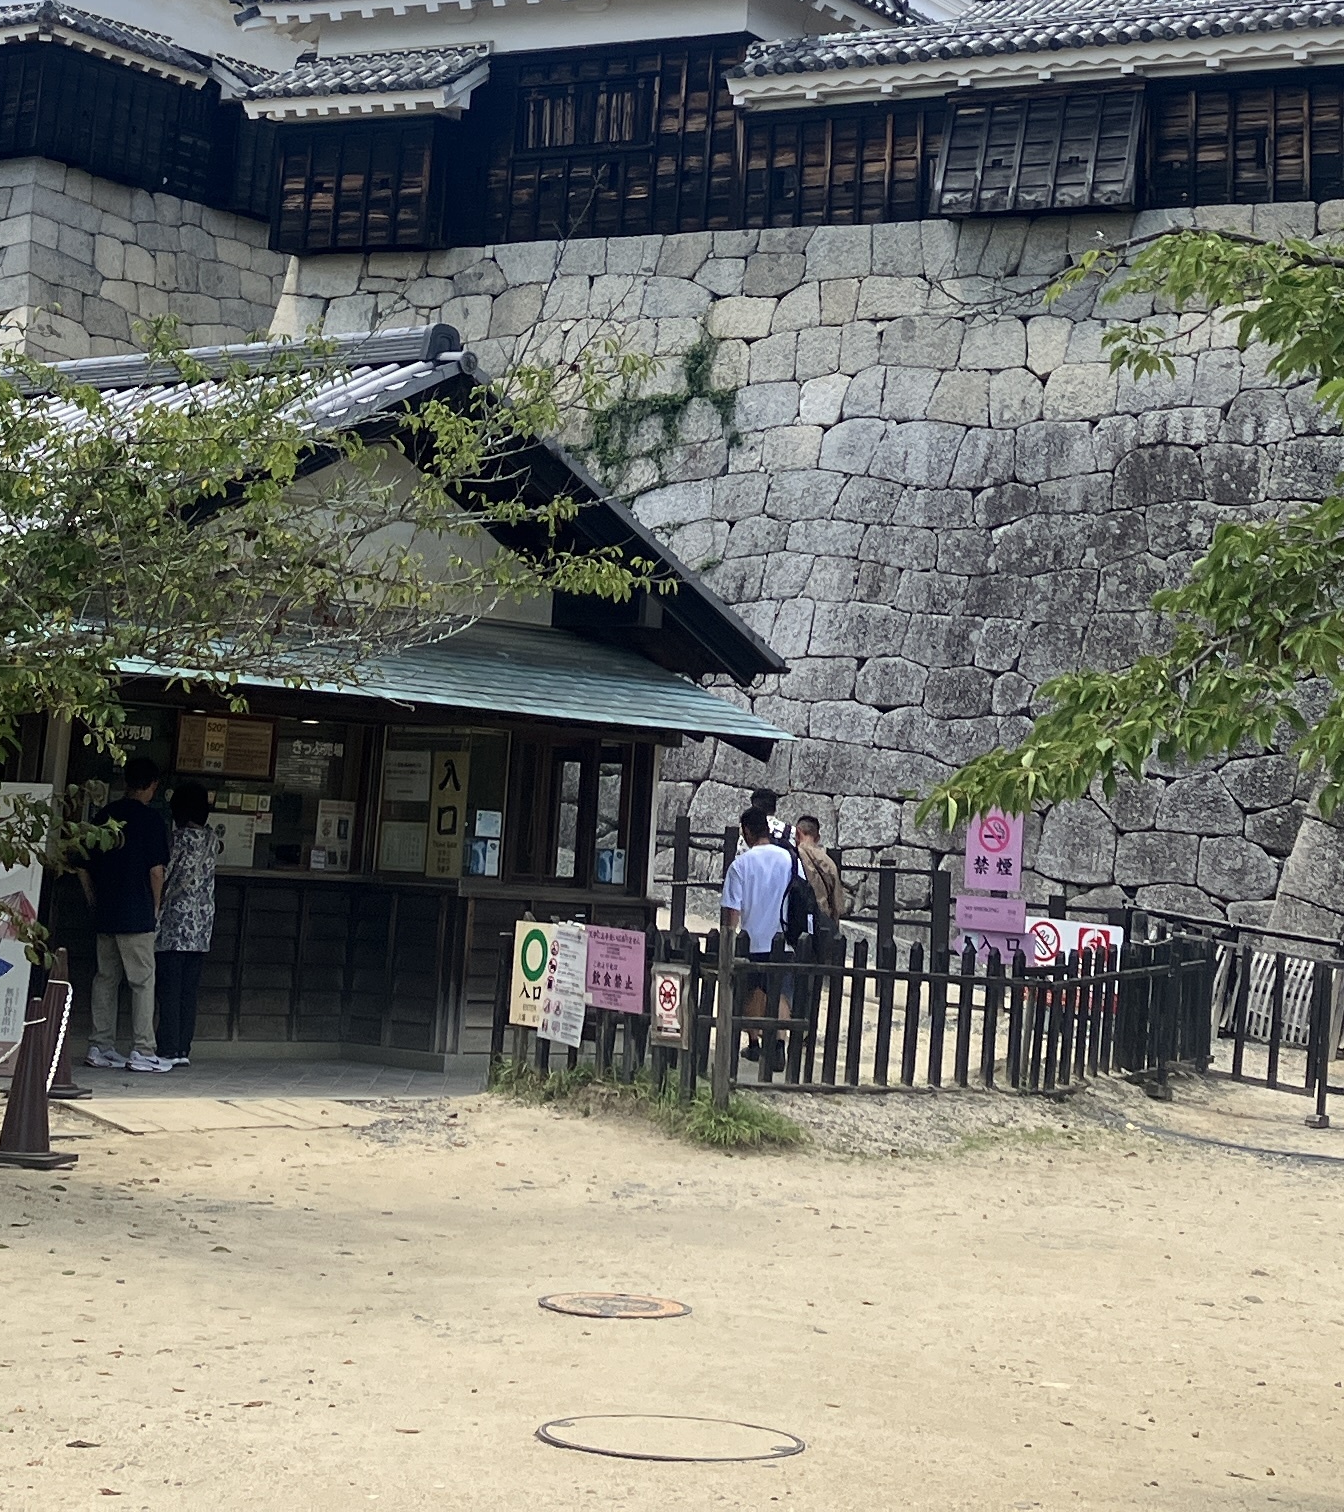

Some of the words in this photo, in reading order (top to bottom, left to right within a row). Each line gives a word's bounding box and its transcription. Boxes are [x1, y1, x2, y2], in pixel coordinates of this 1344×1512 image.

[438, 759, 461, 835] 入口
[973, 855, 1013, 877] 禁煙
[979, 934, 1021, 952] 入口
[591, 970, 634, 990] 飲食禁止
[519, 981, 542, 1001] 入口
